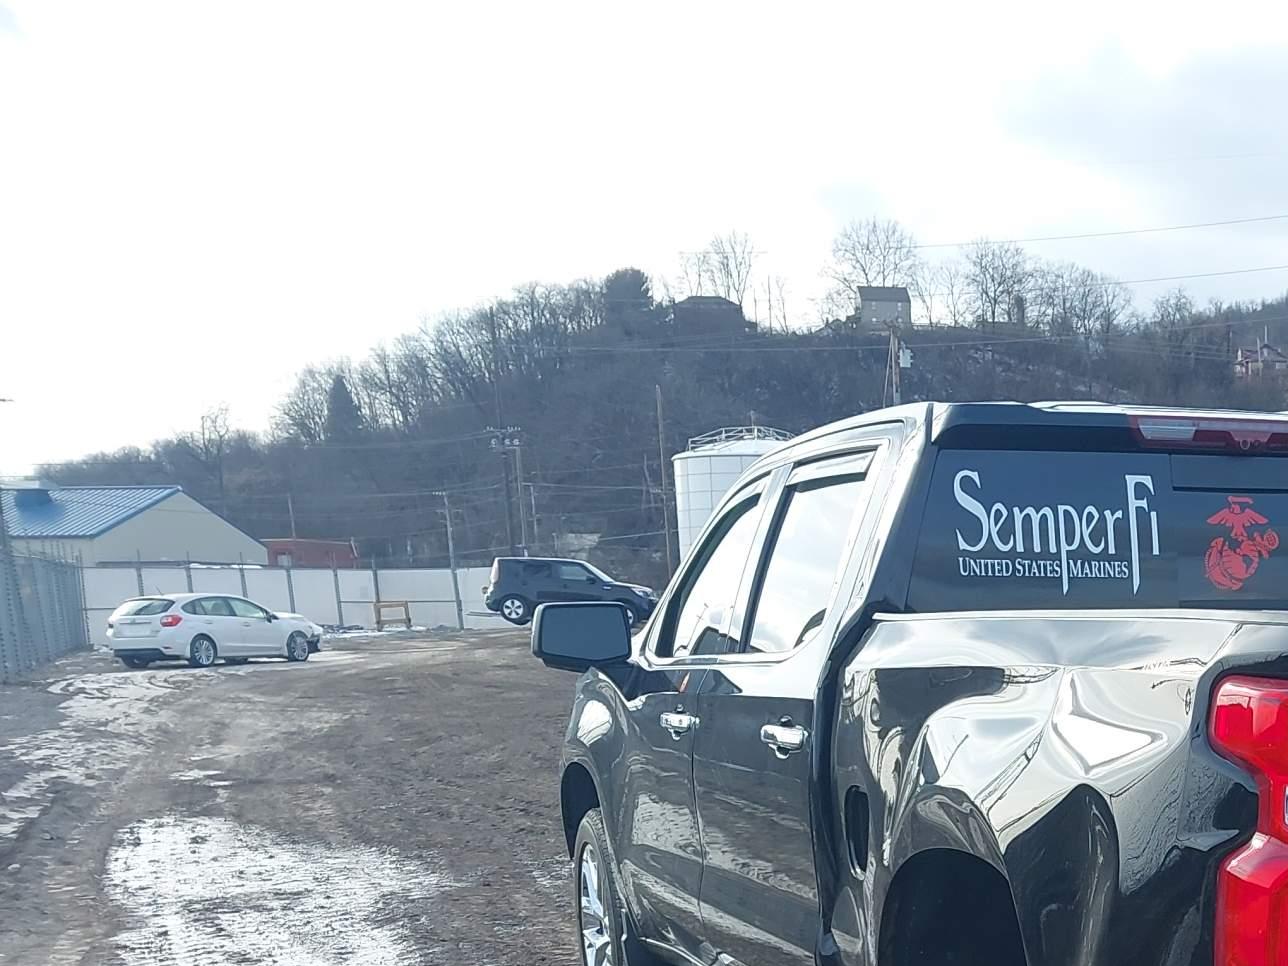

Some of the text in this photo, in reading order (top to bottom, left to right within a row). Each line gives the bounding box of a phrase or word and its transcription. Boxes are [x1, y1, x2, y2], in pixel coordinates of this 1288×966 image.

[953, 469, 1160, 595] Semper Fi
[958, 557, 1129, 578] UNITED STATES MARINES
